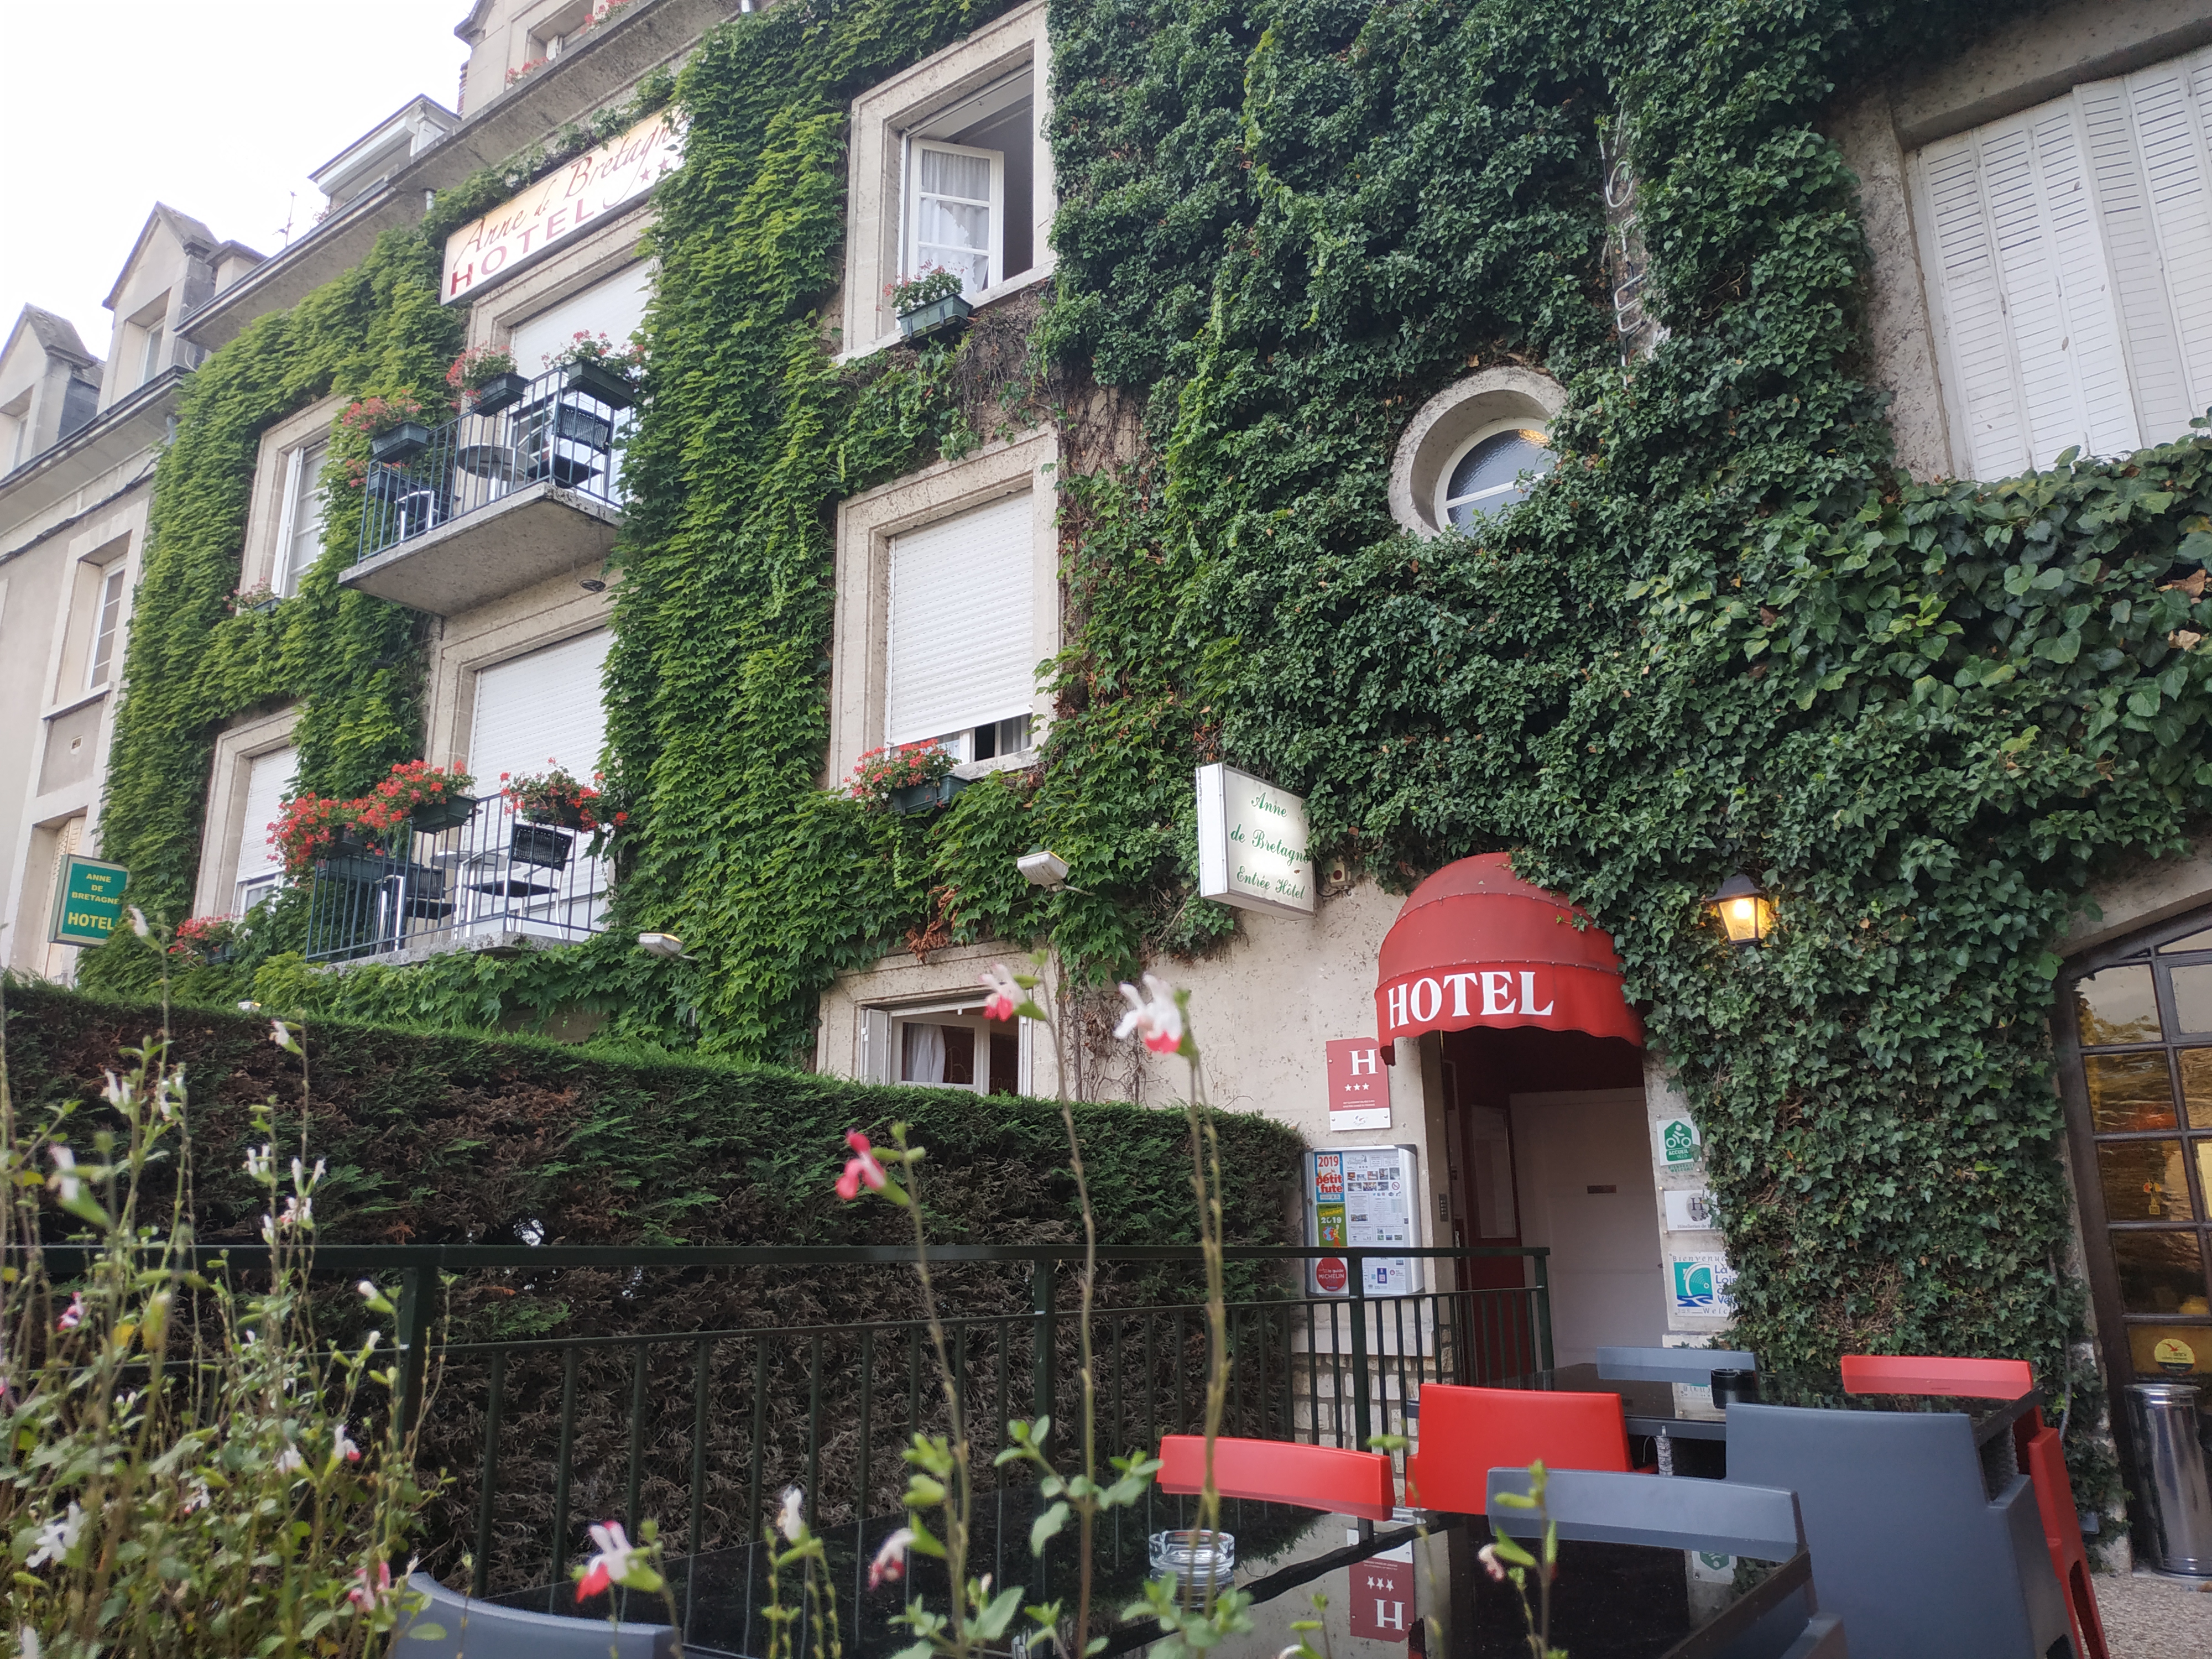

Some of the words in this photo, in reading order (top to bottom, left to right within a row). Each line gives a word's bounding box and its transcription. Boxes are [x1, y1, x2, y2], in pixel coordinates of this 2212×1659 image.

[453, 210, 527, 270] Anne
[534, 179, 556, 217] de
[450, 197, 594, 296] HOTEL
[1251, 792, 1287, 817] Anne
[1230, 823, 1245, 843] de
[1252, 829, 1310, 867] Bretagne
[86, 873, 112, 883] ANNE
[1237, 865, 1271, 890] Entrée
[1275, 879, 1306, 900] Hôtel
[71, 891, 120, 905] BRETAGNE
[67, 912, 114, 931] HOTEL
[1388, 971, 1554, 1030] HOTEL
[1349, 1048, 1379, 1076] H
[1318, 1156, 1339, 1167] 2019
[1316, 1173, 1342, 1186] petit
[1691, 1197, 1704, 1211] H
[1714, 1265, 1728, 1274] La
[1715, 1275, 1737, 1284] Loir
